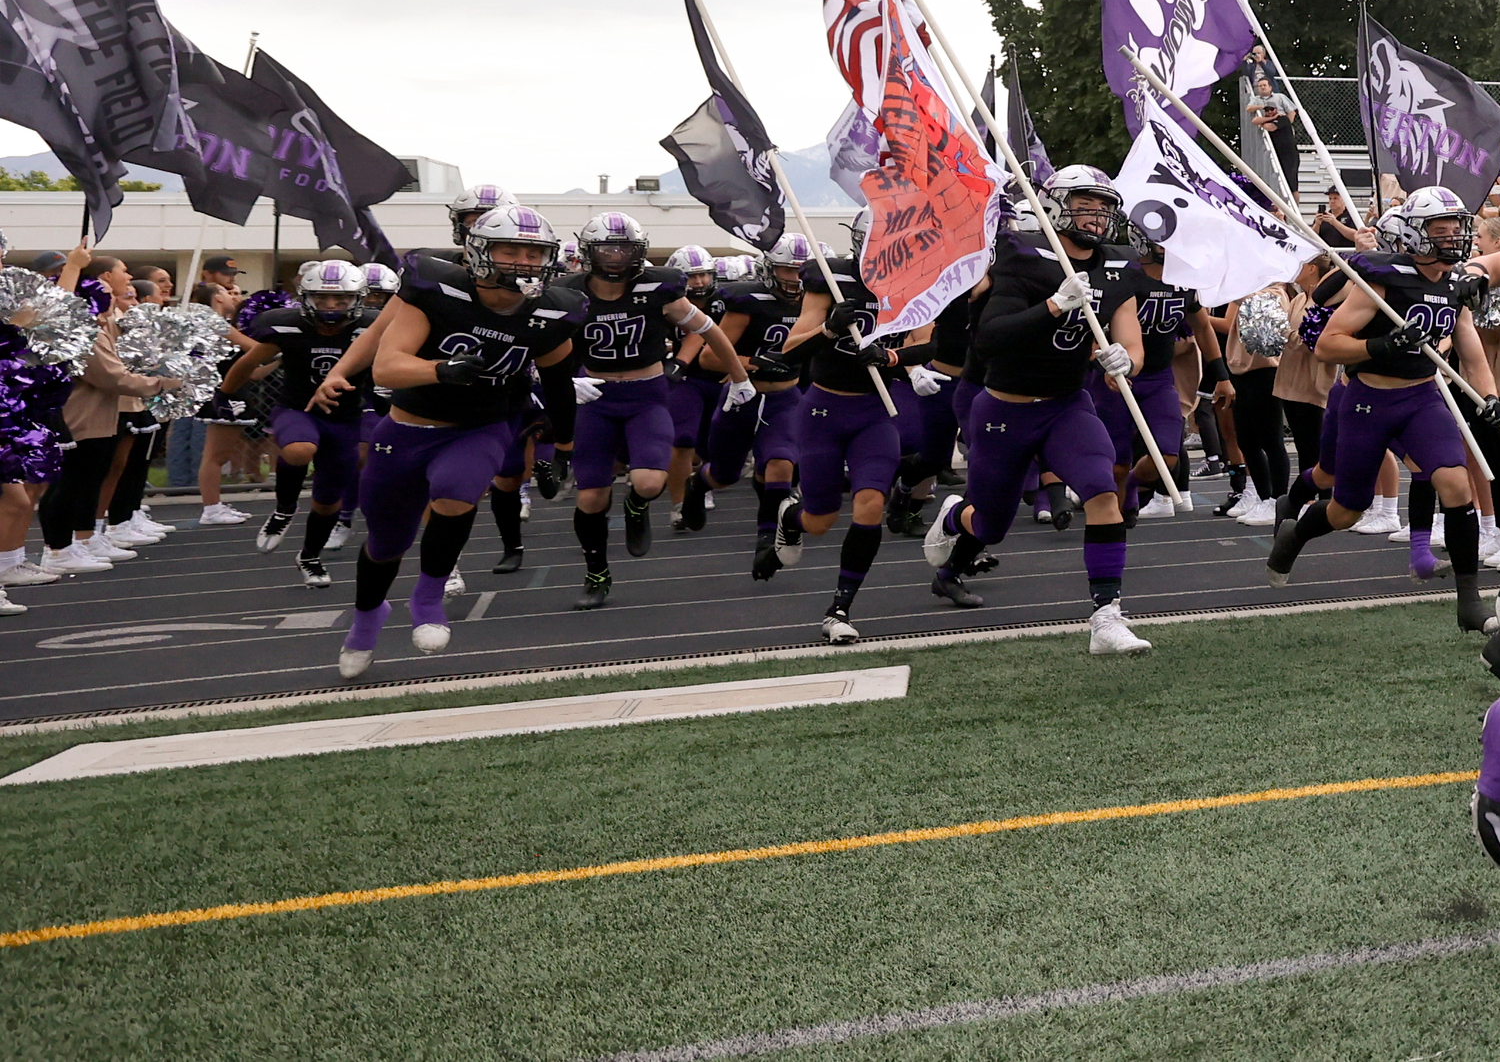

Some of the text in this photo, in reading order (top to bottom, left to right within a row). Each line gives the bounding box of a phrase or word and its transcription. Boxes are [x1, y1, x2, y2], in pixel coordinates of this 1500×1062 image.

[1423, 294, 1448, 304] RIVERTON
[596, 312, 627, 322] RIVERTON
[1137, 298, 1185, 335] 45
[472, 325, 515, 344] RIVERTON
[584, 315, 646, 360] 27
